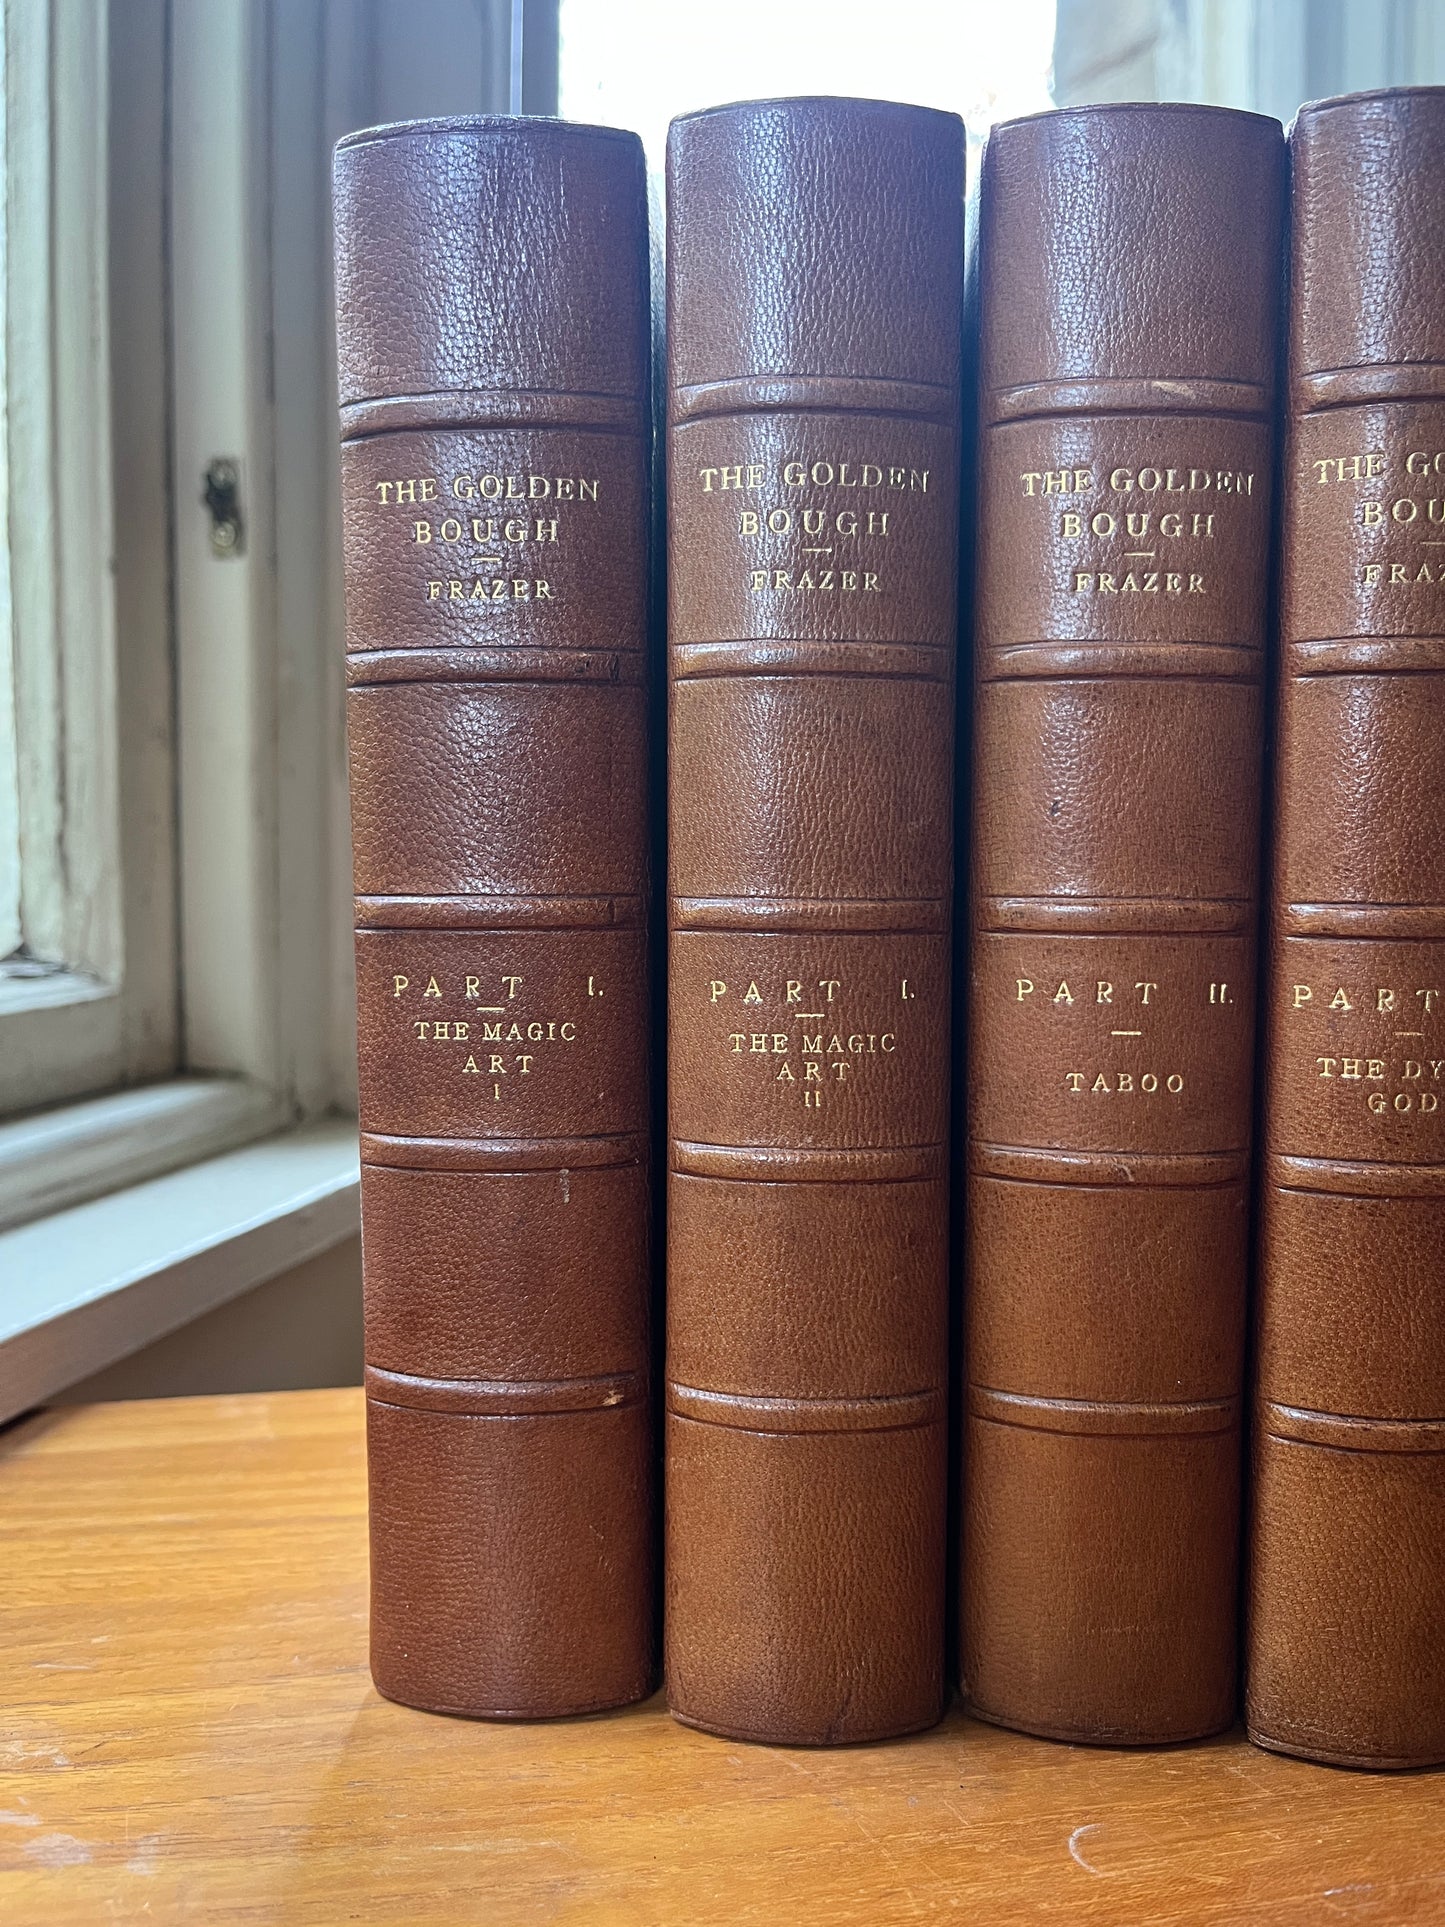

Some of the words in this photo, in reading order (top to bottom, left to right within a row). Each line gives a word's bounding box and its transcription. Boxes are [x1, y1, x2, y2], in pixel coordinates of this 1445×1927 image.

[700, 464, 766, 493] THE
[783, 462, 930, 493] GOLDEN
[1313, 453, 1385, 484] THE
[375, 478, 439, 505] THE
[453, 475, 600, 502] GOLDEN
[1020, 469, 1092, 497] THE
[1109, 468, 1255, 496] GOLDEN
[740, 510, 890, 537] BOUGH
[1361, 498, 1445, 527] BOU
[414, 519, 558, 544] BOUGH
[1062, 513, 1215, 539] BOUGH
[427, 580, 555, 600] FRAZER
[750, 570, 882, 592] FRAZER
[1074, 572, 1206, 594] FRAZER
[392, 975, 523, 999] PART
[709, 980, 841, 1003] PART
[1016, 979, 1157, 1005] PART
[1209, 983, 1233, 1004] II.
[1292, 984, 1439, 1014] PART
[414, 1021, 470, 1041] THE
[482, 1022, 577, 1041] MAGIC
[729, 1033, 789, 1053] THE
[801, 1033, 896, 1054] MAGIC
[462, 1055, 533, 1074] ART
[776, 1062, 850, 1081] ART
[1316, 1057, 1385, 1080] THE
[1402, 1060, 1445, 1080] DY
[1066, 1072, 1184, 1093] TABOO
[804, 1091, 821, 1107] II
[1367, 1092, 1438, 1114] GOD
